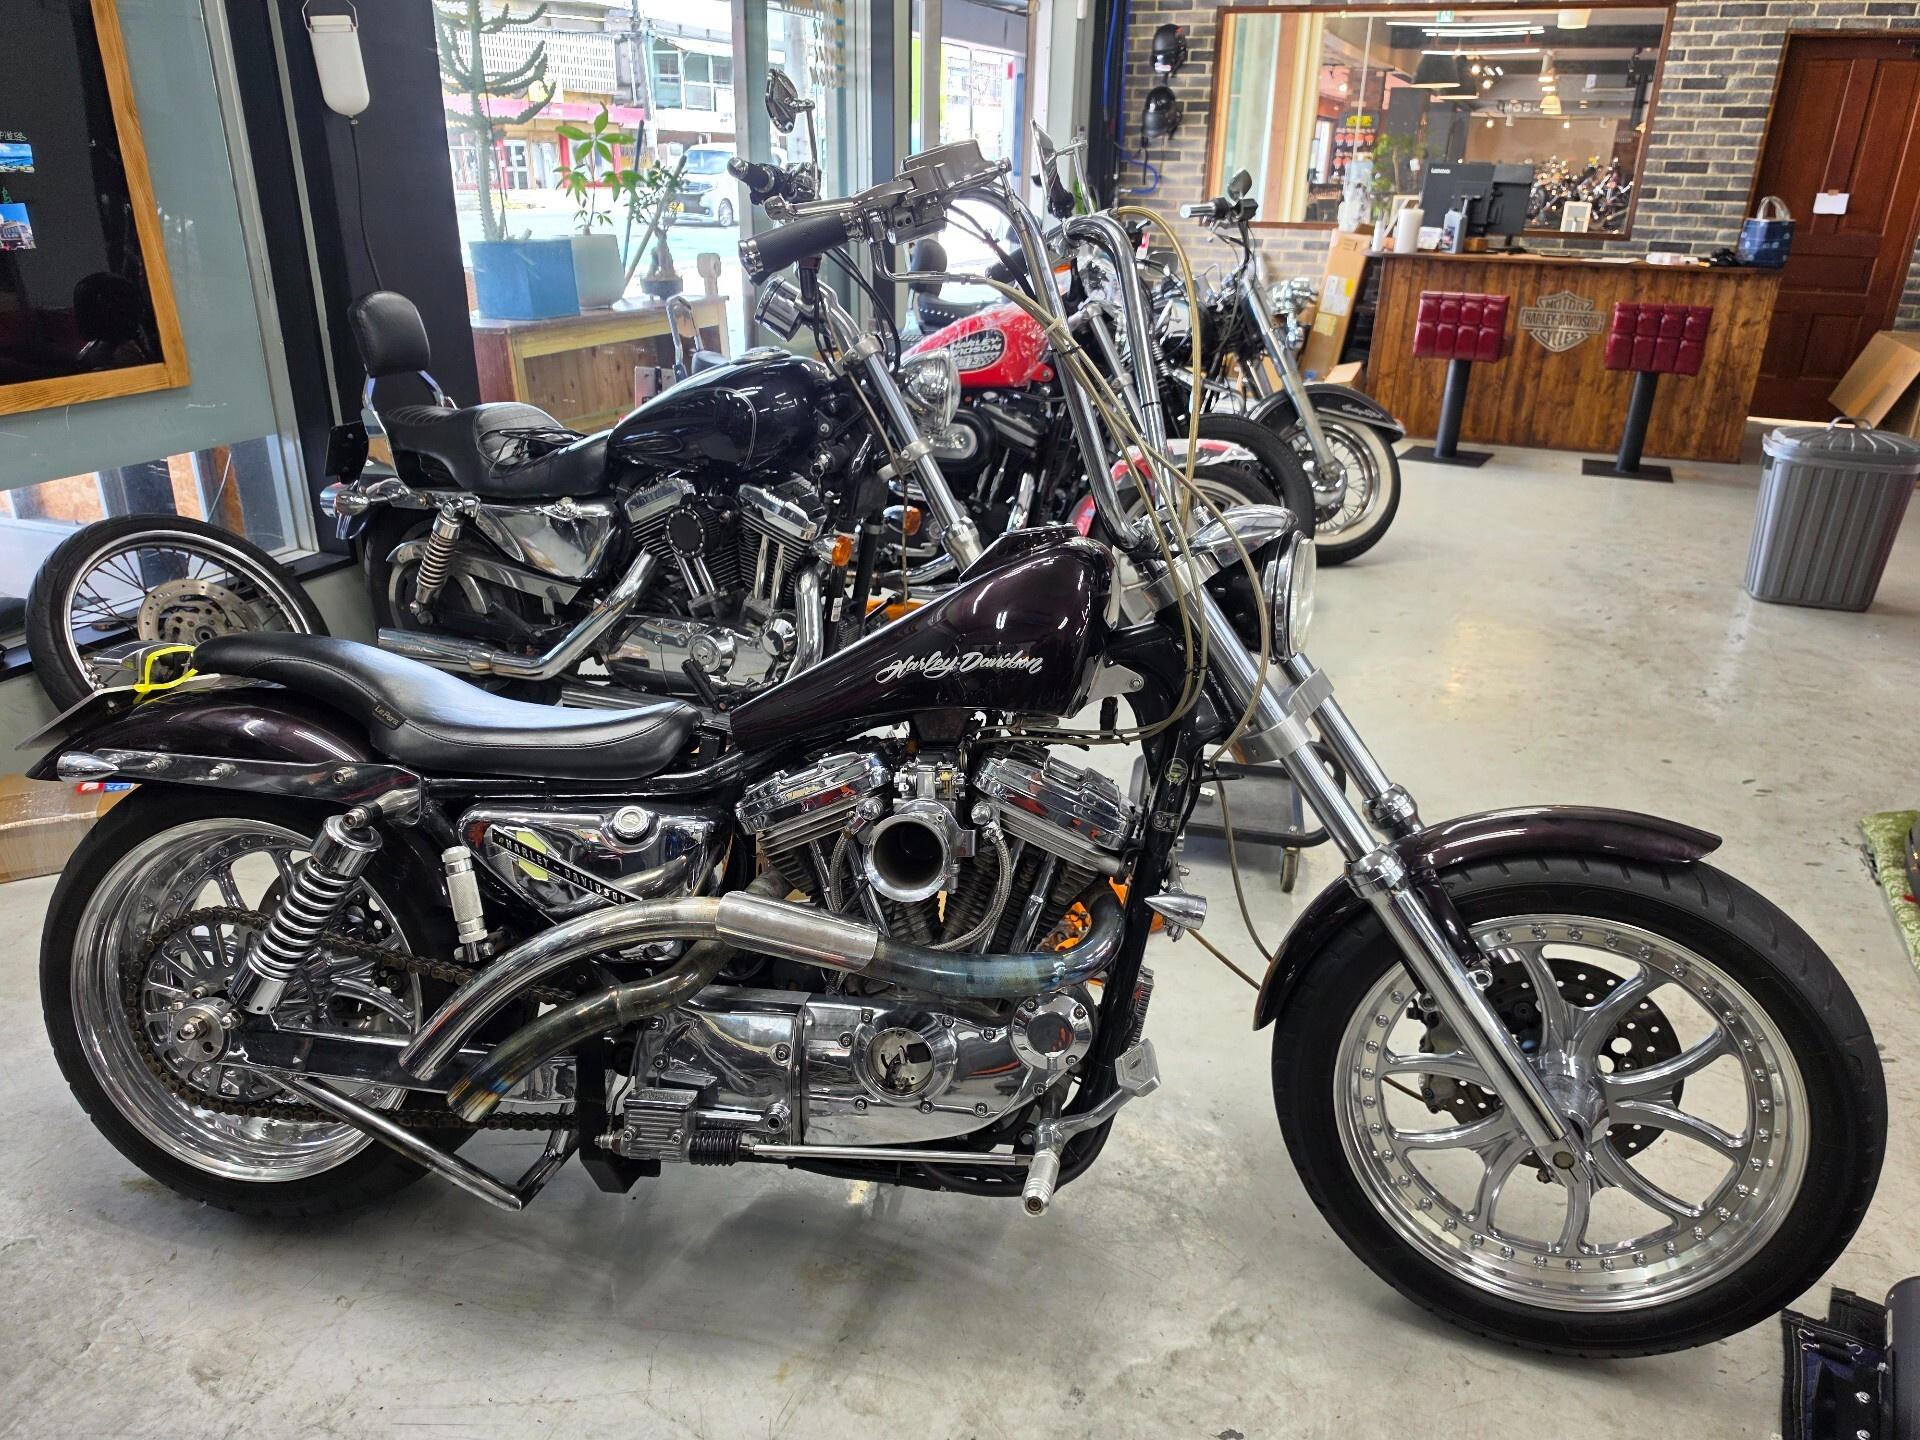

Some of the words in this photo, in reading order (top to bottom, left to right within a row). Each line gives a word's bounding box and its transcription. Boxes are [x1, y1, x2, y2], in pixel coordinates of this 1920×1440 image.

[1545, 297, 1584, 311] MOTOR
[1524, 312, 1598, 328] HARLEY-DAVIDSON
[1539, 330, 1579, 346] CYCLES
